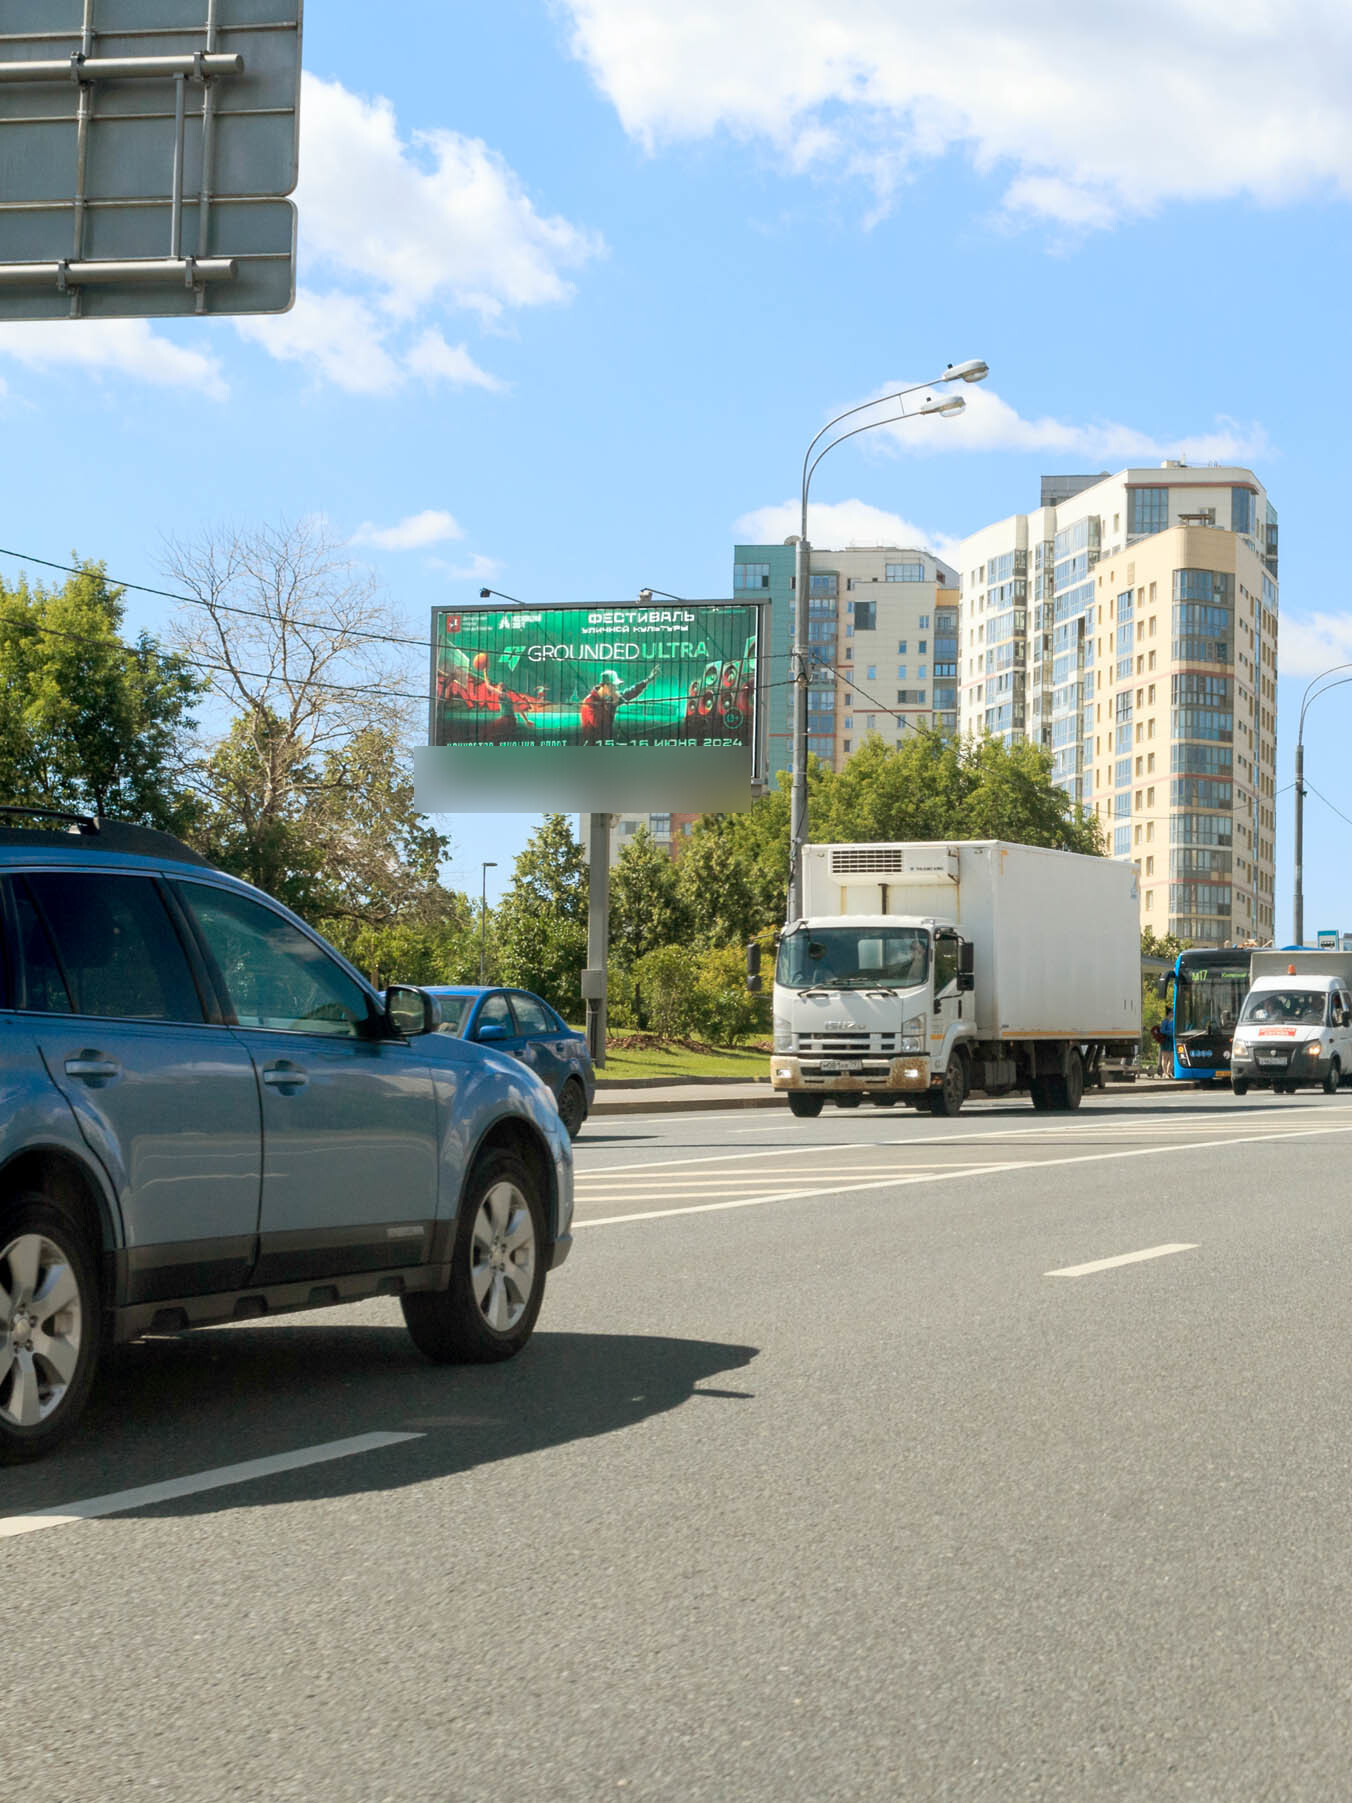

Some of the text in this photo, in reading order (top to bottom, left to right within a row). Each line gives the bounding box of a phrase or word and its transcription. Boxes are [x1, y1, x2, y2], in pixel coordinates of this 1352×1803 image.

[588, 611, 695, 624] ФЕСТИВАЛЬ
[581, 624, 689, 634] УЛИЧНОЙ КУЛЬТУРЫ
[528, 642, 710, 662] GROUNDED ULTRA
[703, 738, 743, 746] 2024
